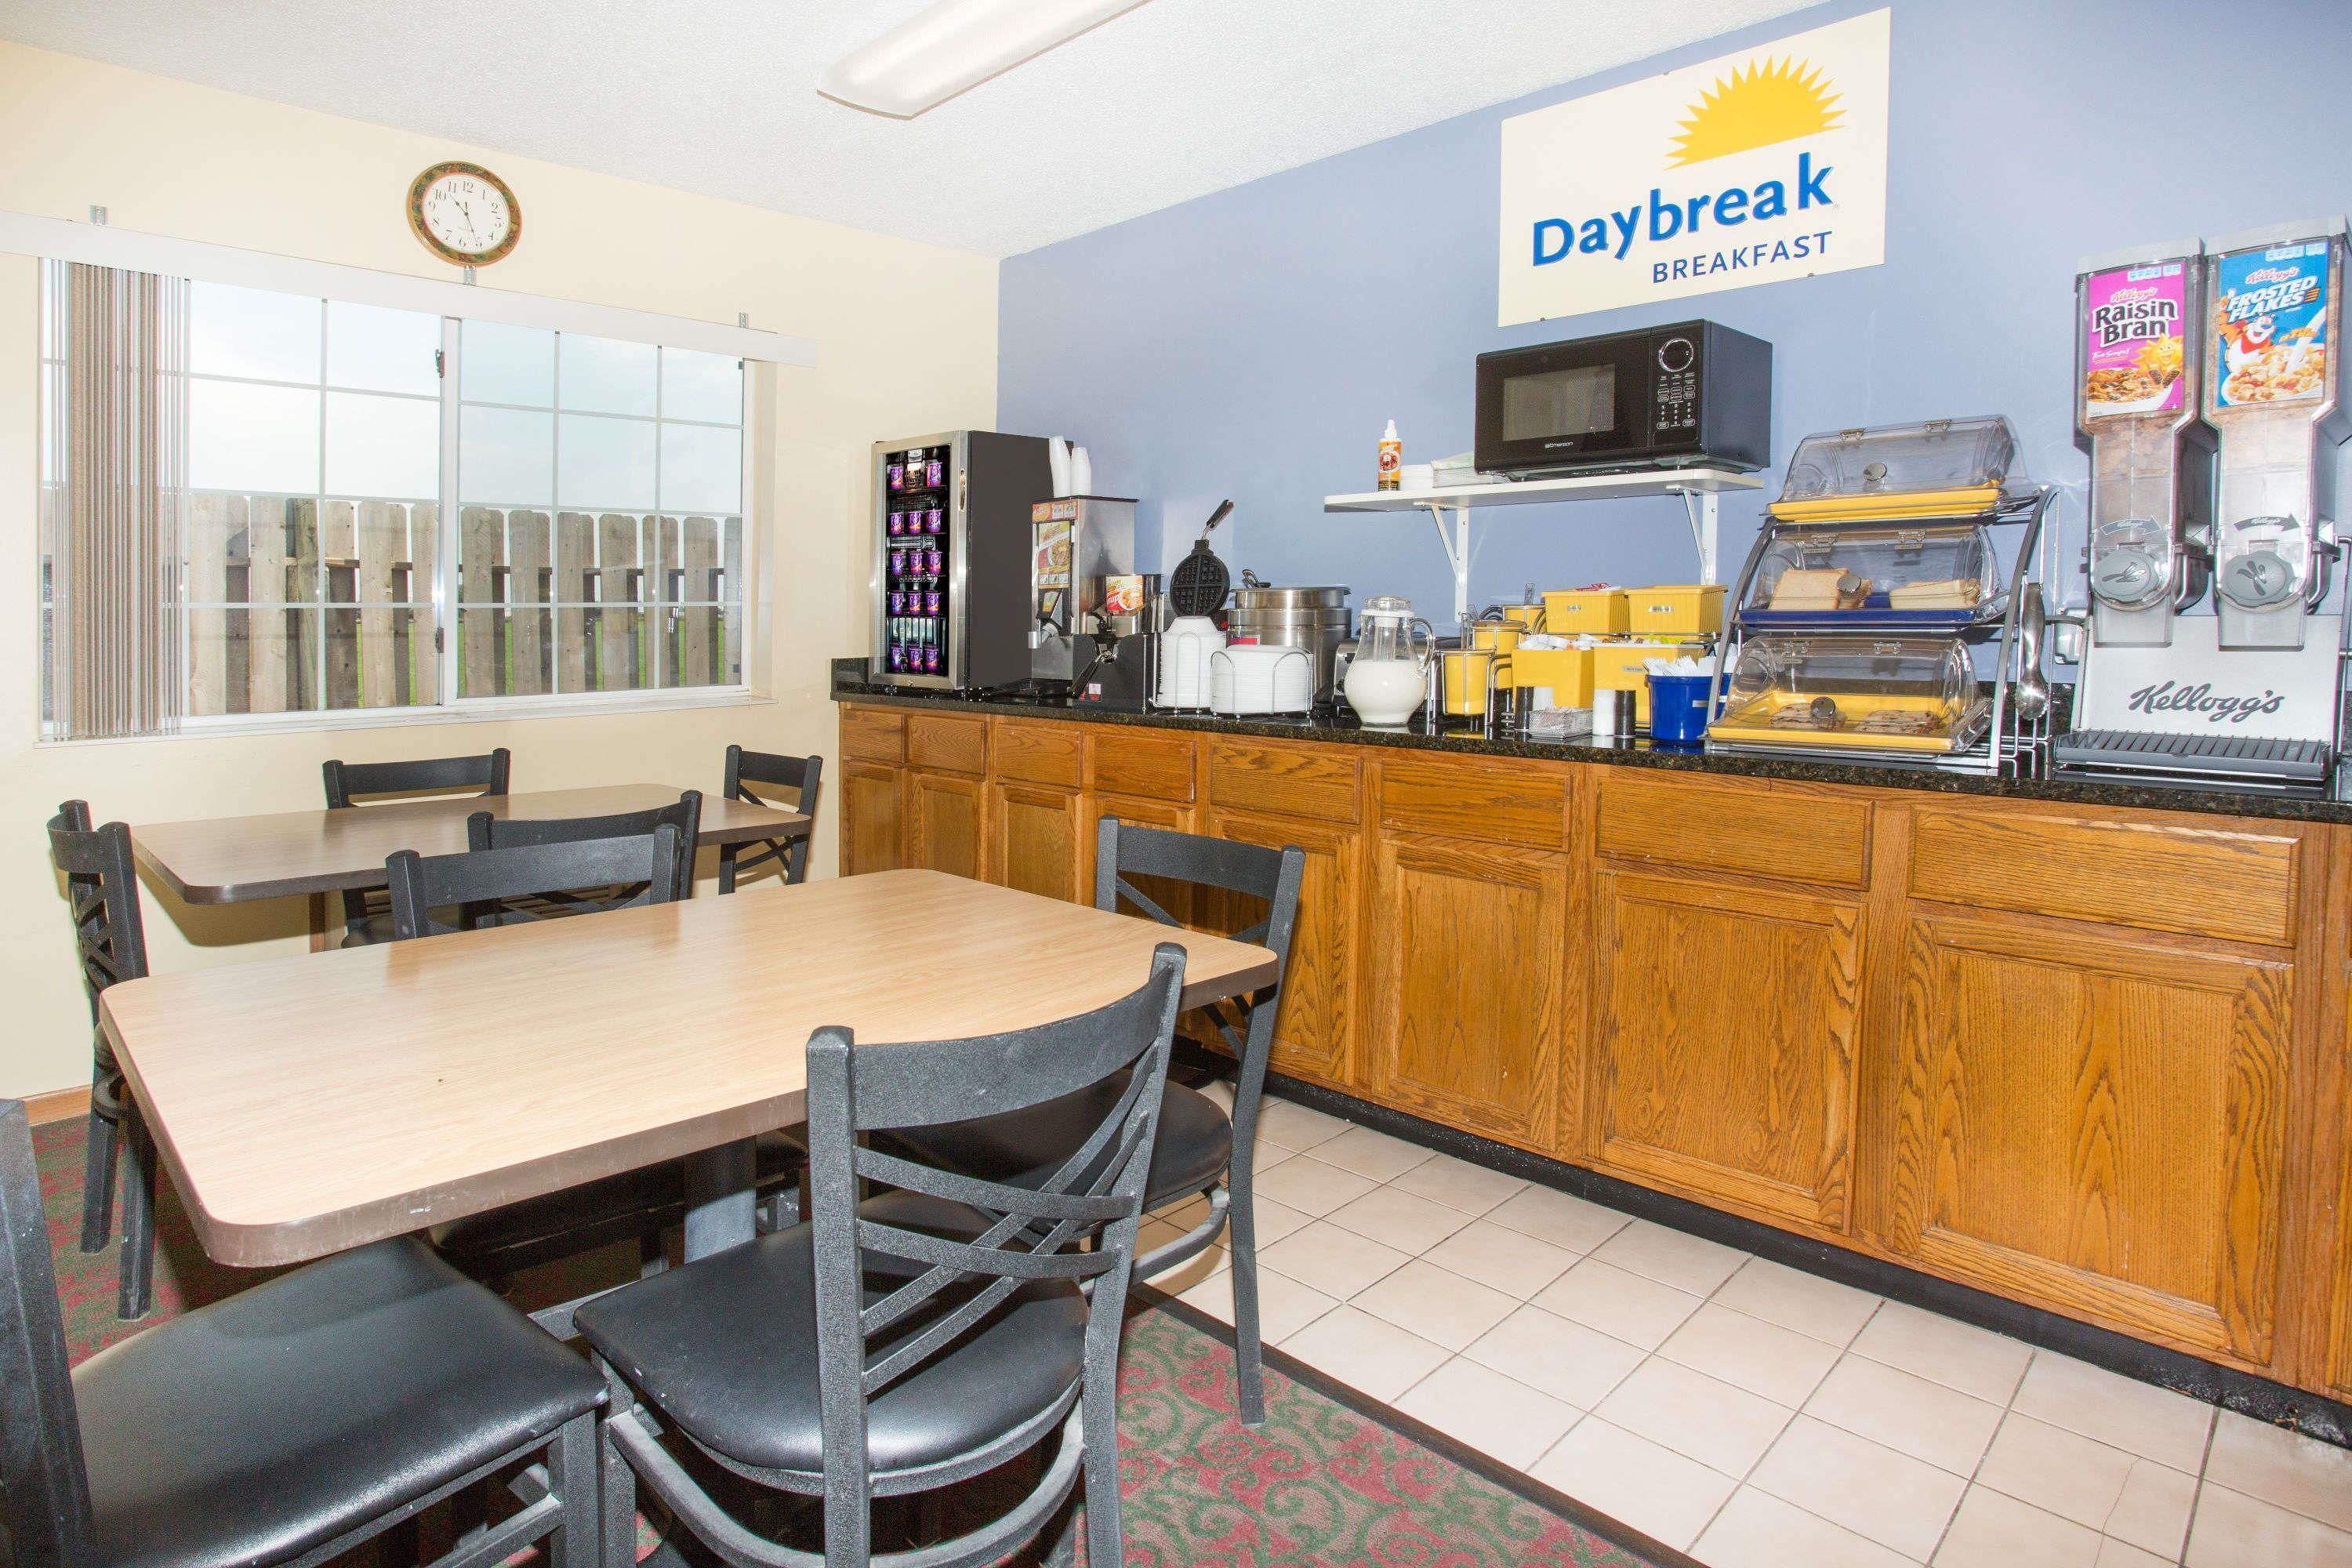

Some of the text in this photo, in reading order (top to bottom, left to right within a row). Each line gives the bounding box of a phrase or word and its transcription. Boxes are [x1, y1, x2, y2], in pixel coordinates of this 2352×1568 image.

[435, 189, 447, 201] 10
[463, 180, 474, 194] 12
[1533, 151, 1834, 267] Daybreak
[445, 229, 452, 241] 7
[1653, 231, 1833, 283] BREAKFAST
[2227, 275, 2318, 311] FROSTED
[2227, 291, 2305, 323] FLAKES
[2095, 300, 2176, 329] Raisin
[2103, 320, 2166, 345] Bran
[2129, 680, 2285, 723] Kellogg's
